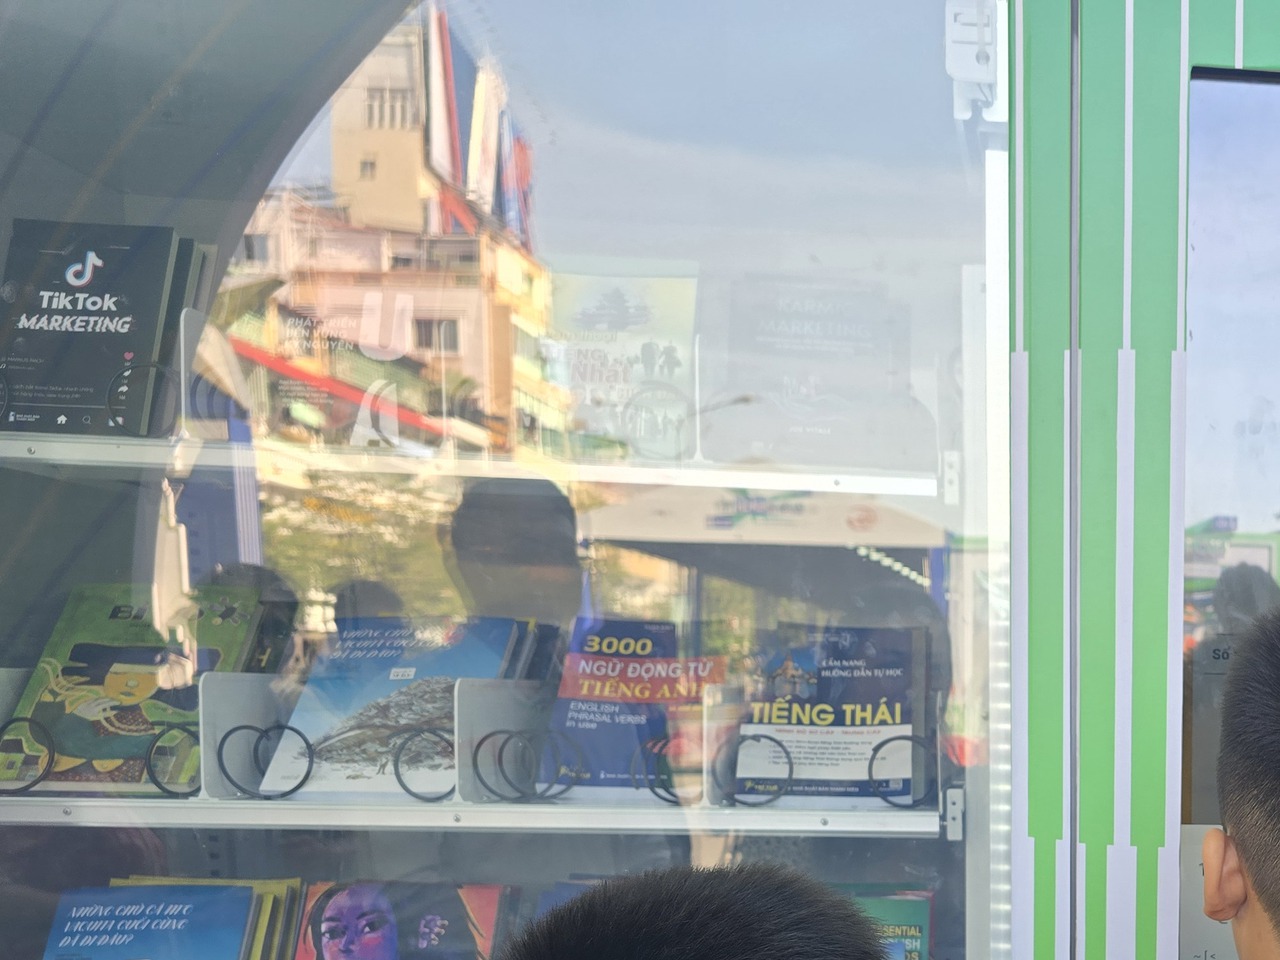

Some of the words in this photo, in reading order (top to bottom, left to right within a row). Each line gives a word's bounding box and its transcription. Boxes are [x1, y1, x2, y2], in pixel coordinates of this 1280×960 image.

[39, 290, 119, 311] TikTok
[17, 313, 132, 333] MARKETING
[584, 635, 653, 656] 3000
[569, 701, 620, 713] ENGLISH
[751, 694, 835, 726] TIẾNG
[842, 697, 902, 726] THÁI
[567, 711, 612, 723] PHRASAL
[614, 714, 647, 725] VERBS
[874, 924, 922, 937] SENTIAL
